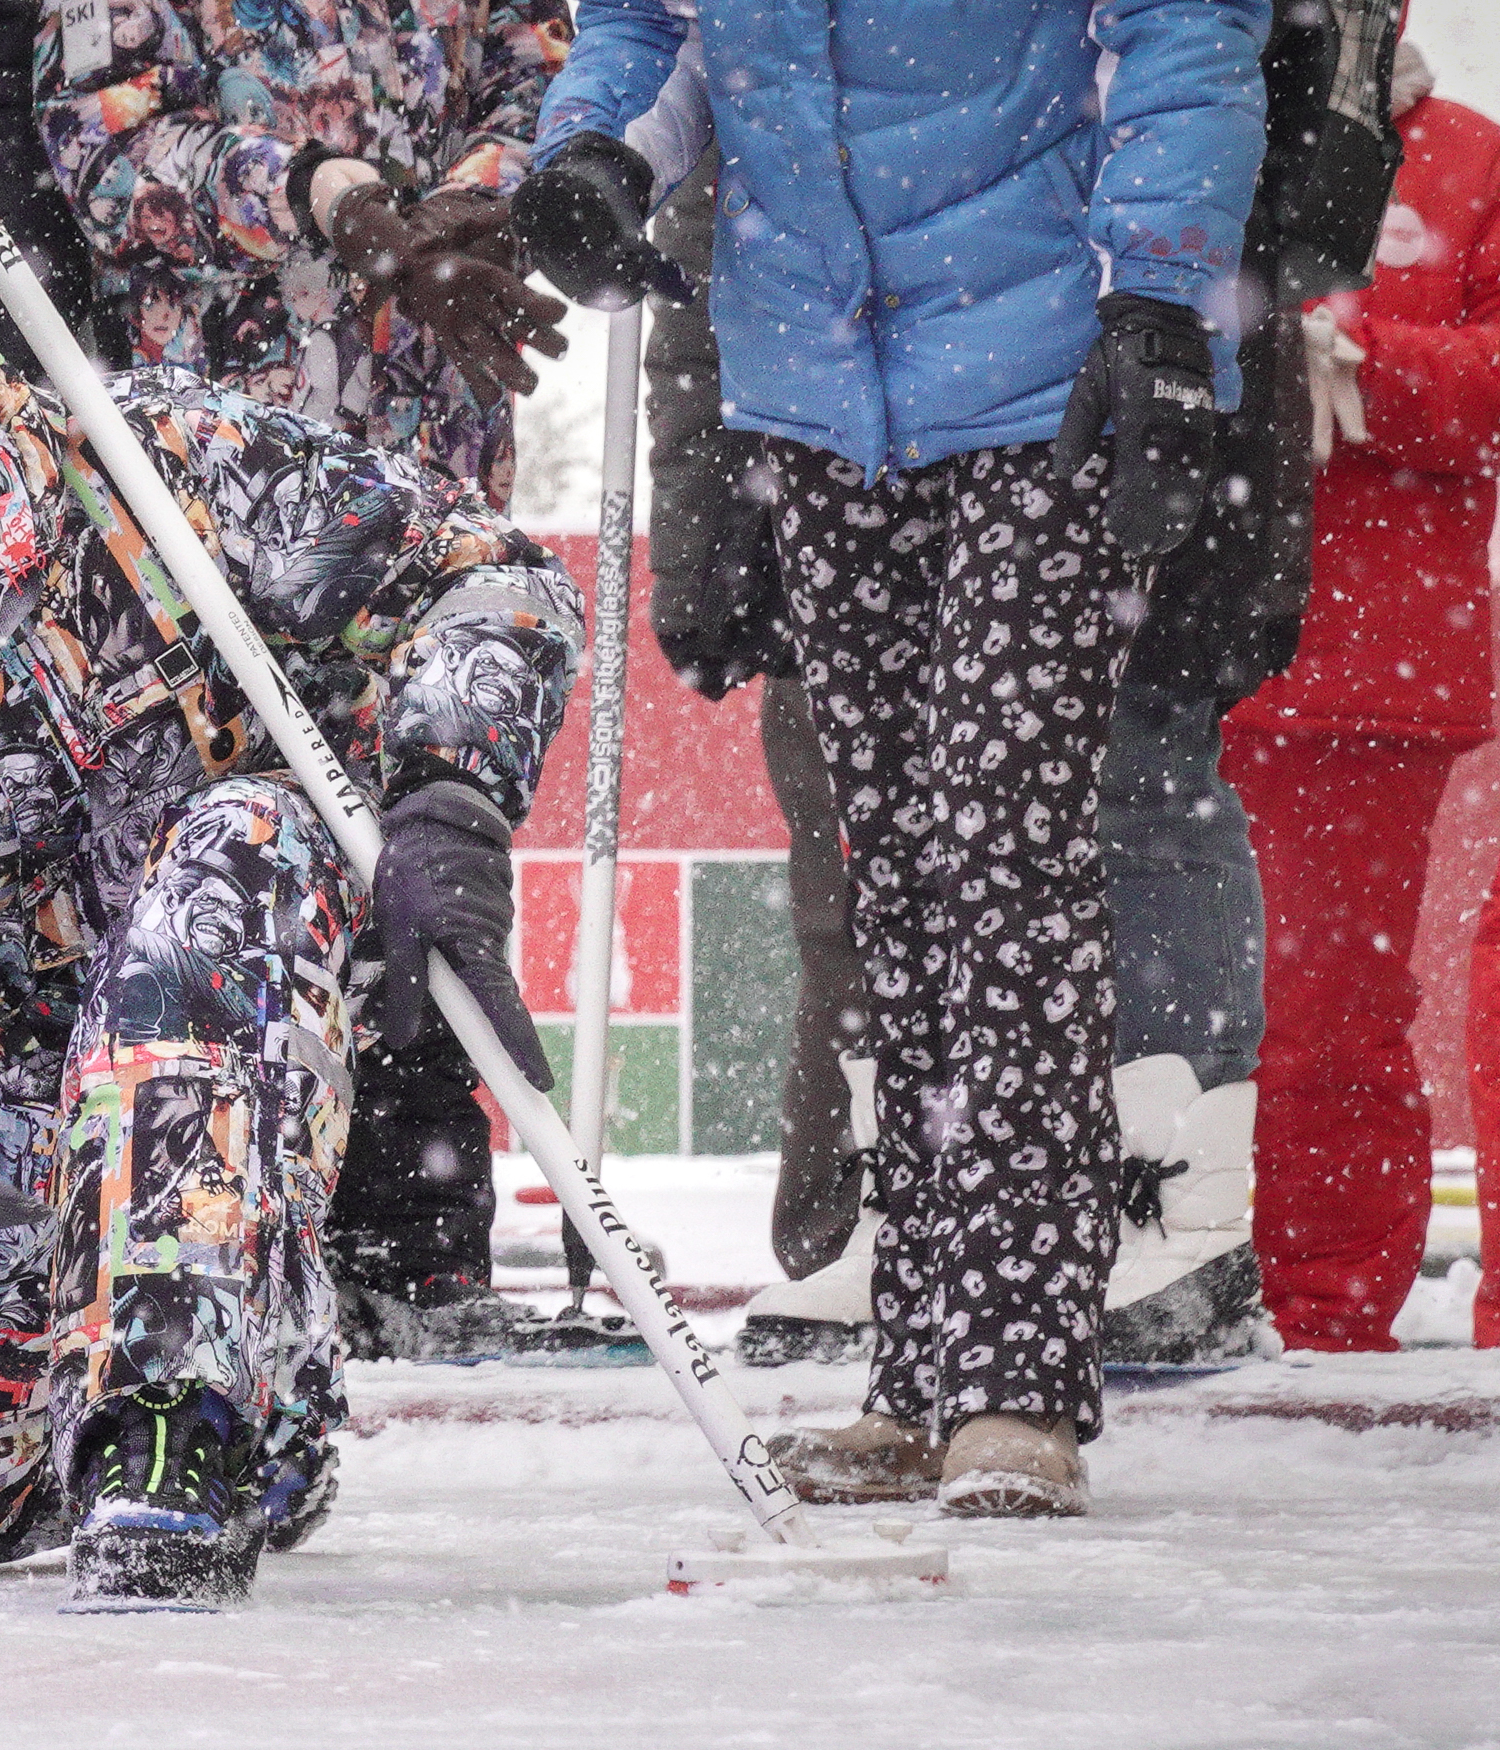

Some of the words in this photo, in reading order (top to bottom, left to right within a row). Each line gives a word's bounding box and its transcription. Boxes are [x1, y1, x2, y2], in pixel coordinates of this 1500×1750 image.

[65, 2, 95, 28] SKI
[228, 611, 261, 658] PATENTED
[595, 563, 622, 700] Fiberglass
[295, 710, 366, 818] TAPERED
[592, 712, 613, 792] Olson
[573, 1158, 722, 1389] BalancePlus
